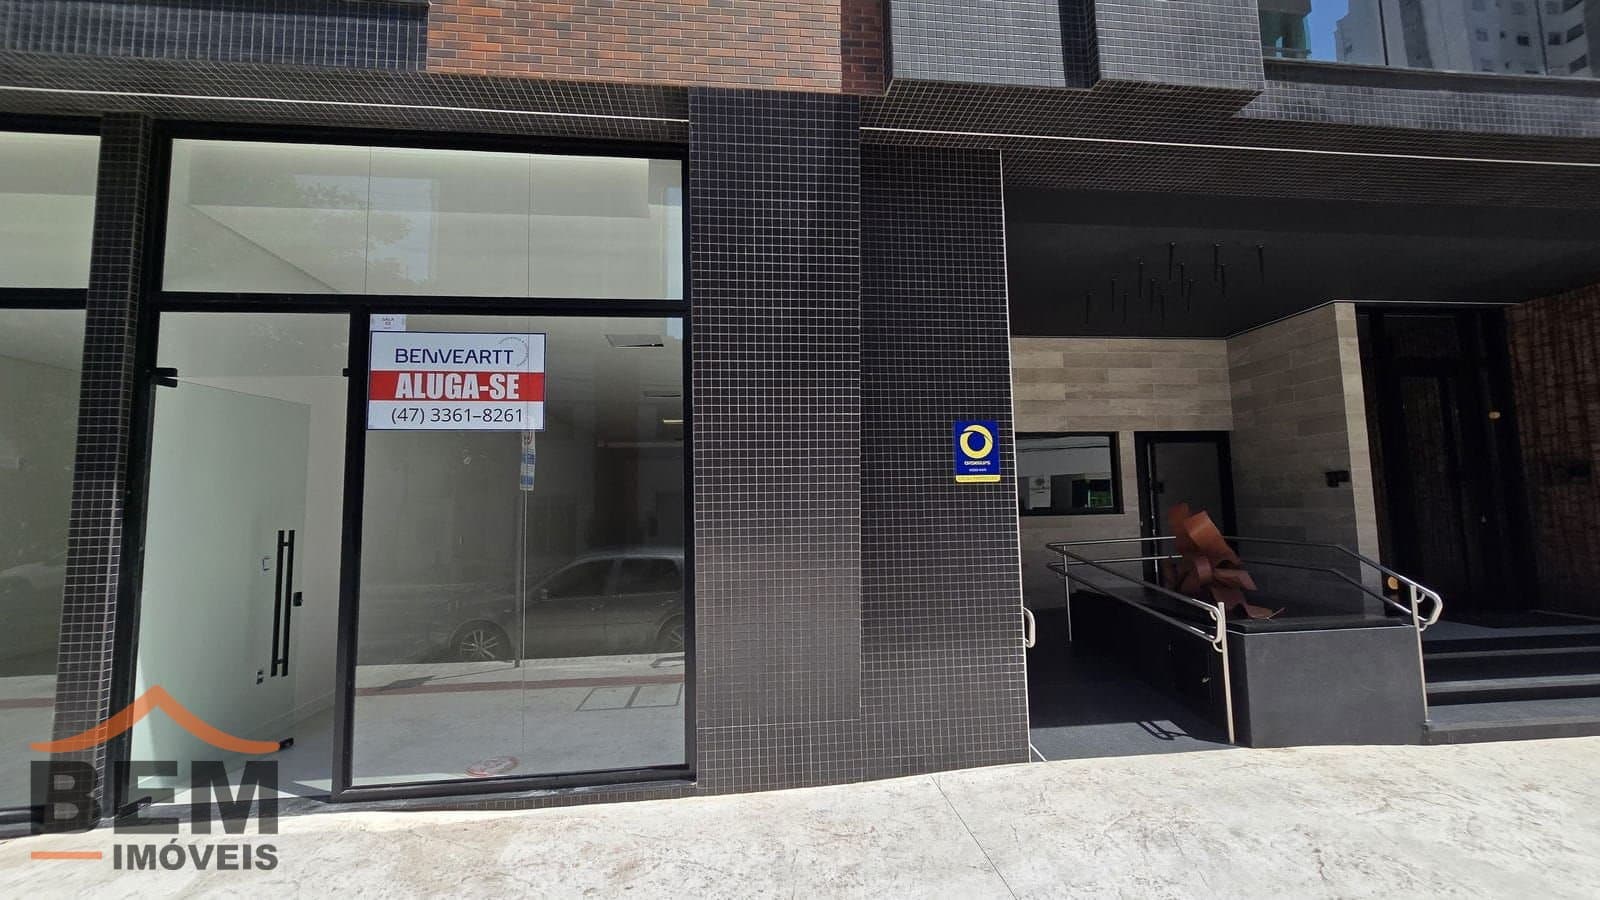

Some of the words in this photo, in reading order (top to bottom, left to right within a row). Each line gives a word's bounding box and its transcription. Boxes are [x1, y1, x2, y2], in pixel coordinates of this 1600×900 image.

[395, 348, 514, 364] BENVEARTT
[395, 373, 520, 400] ALUGA-SE
[391, 407, 425, 425] (47)
[430, 408, 522, 423] 3361-8261
